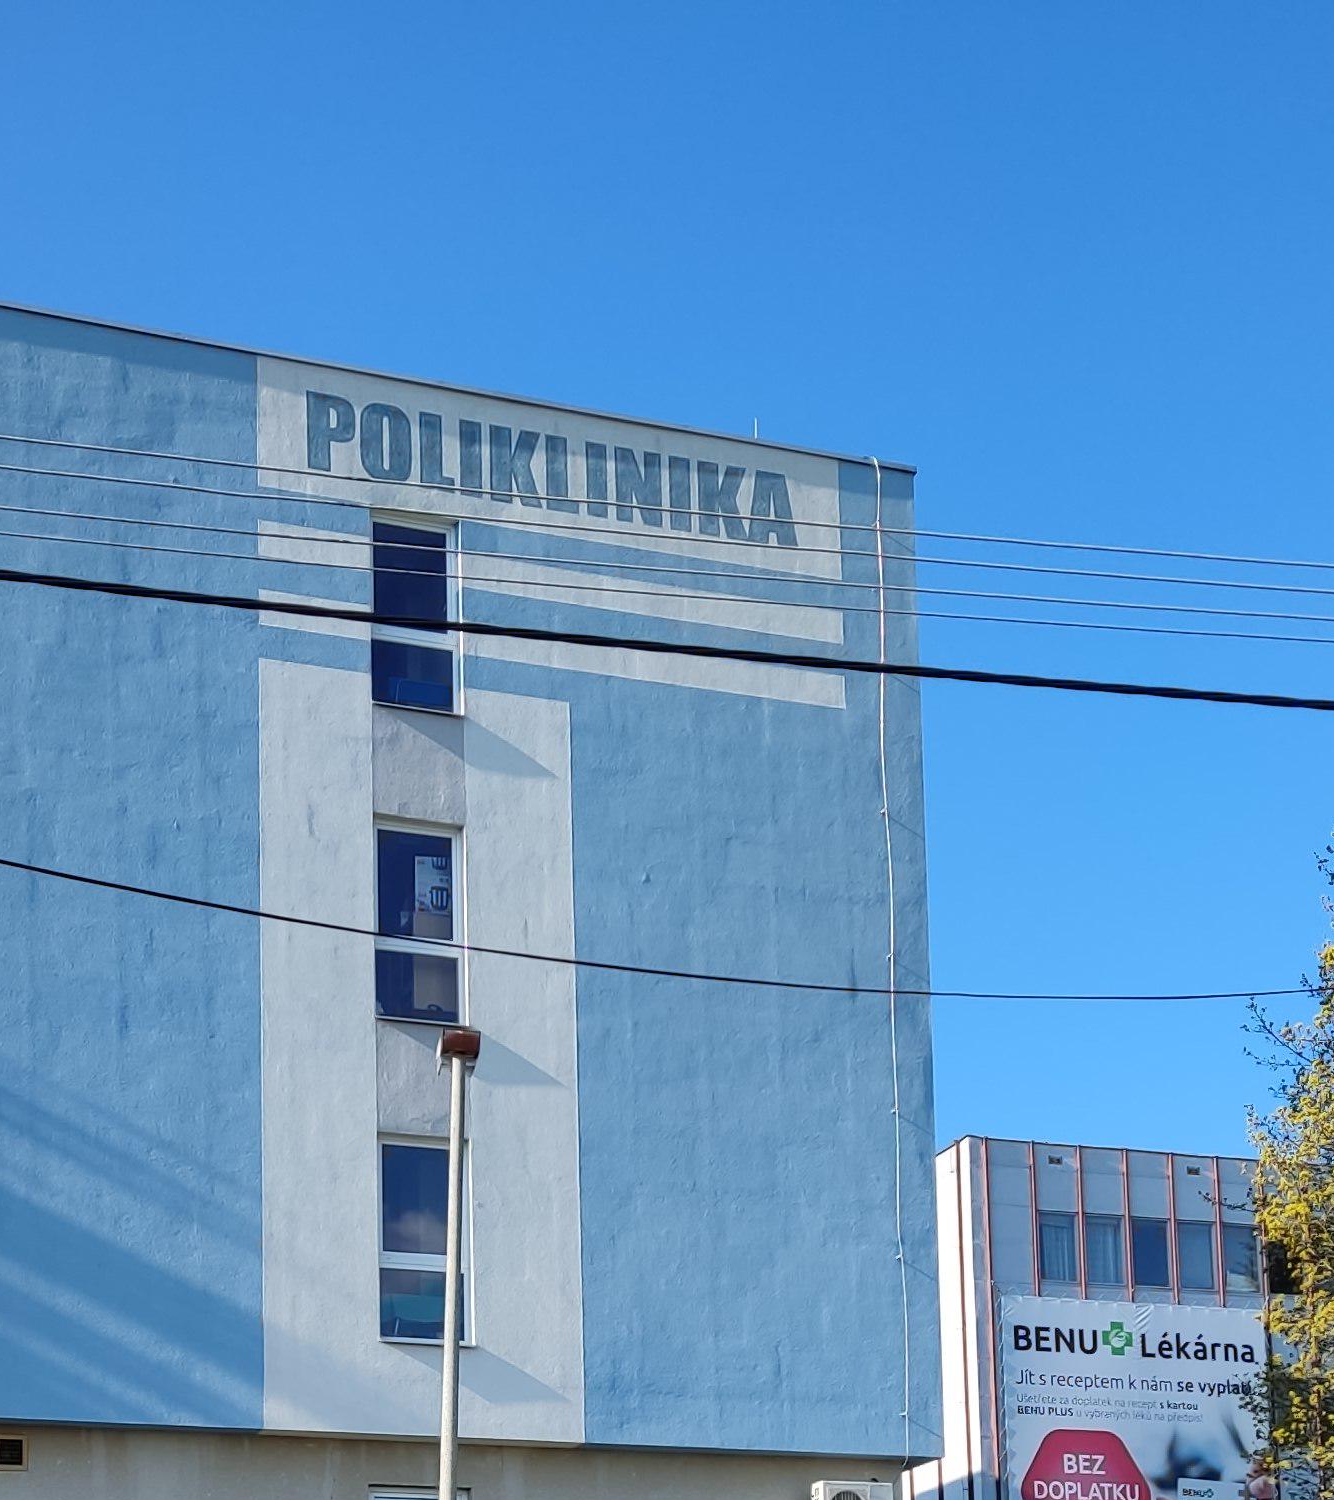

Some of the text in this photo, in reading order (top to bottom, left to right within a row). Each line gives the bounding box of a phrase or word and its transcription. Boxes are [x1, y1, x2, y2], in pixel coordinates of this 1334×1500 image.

[305, 390, 798, 547] POLIKLINIKA
[1013, 1325, 1255, 1363] BENU Lékárna
[1015, 1368, 1035, 1385] Jít
[1039, 1374, 1047, 1386] s
[1050, 1373, 1124, 1392] receptem
[1128, 1374, 1137, 1390] k
[1140, 1376, 1173, 1392] nám
[1177, 1380, 1194, 1393] se
[1048, 1406, 1074, 1417] PLUS
[1167, 1400, 1199, 1411] kartou
[1063, 1453, 1106, 1475] BEZ
